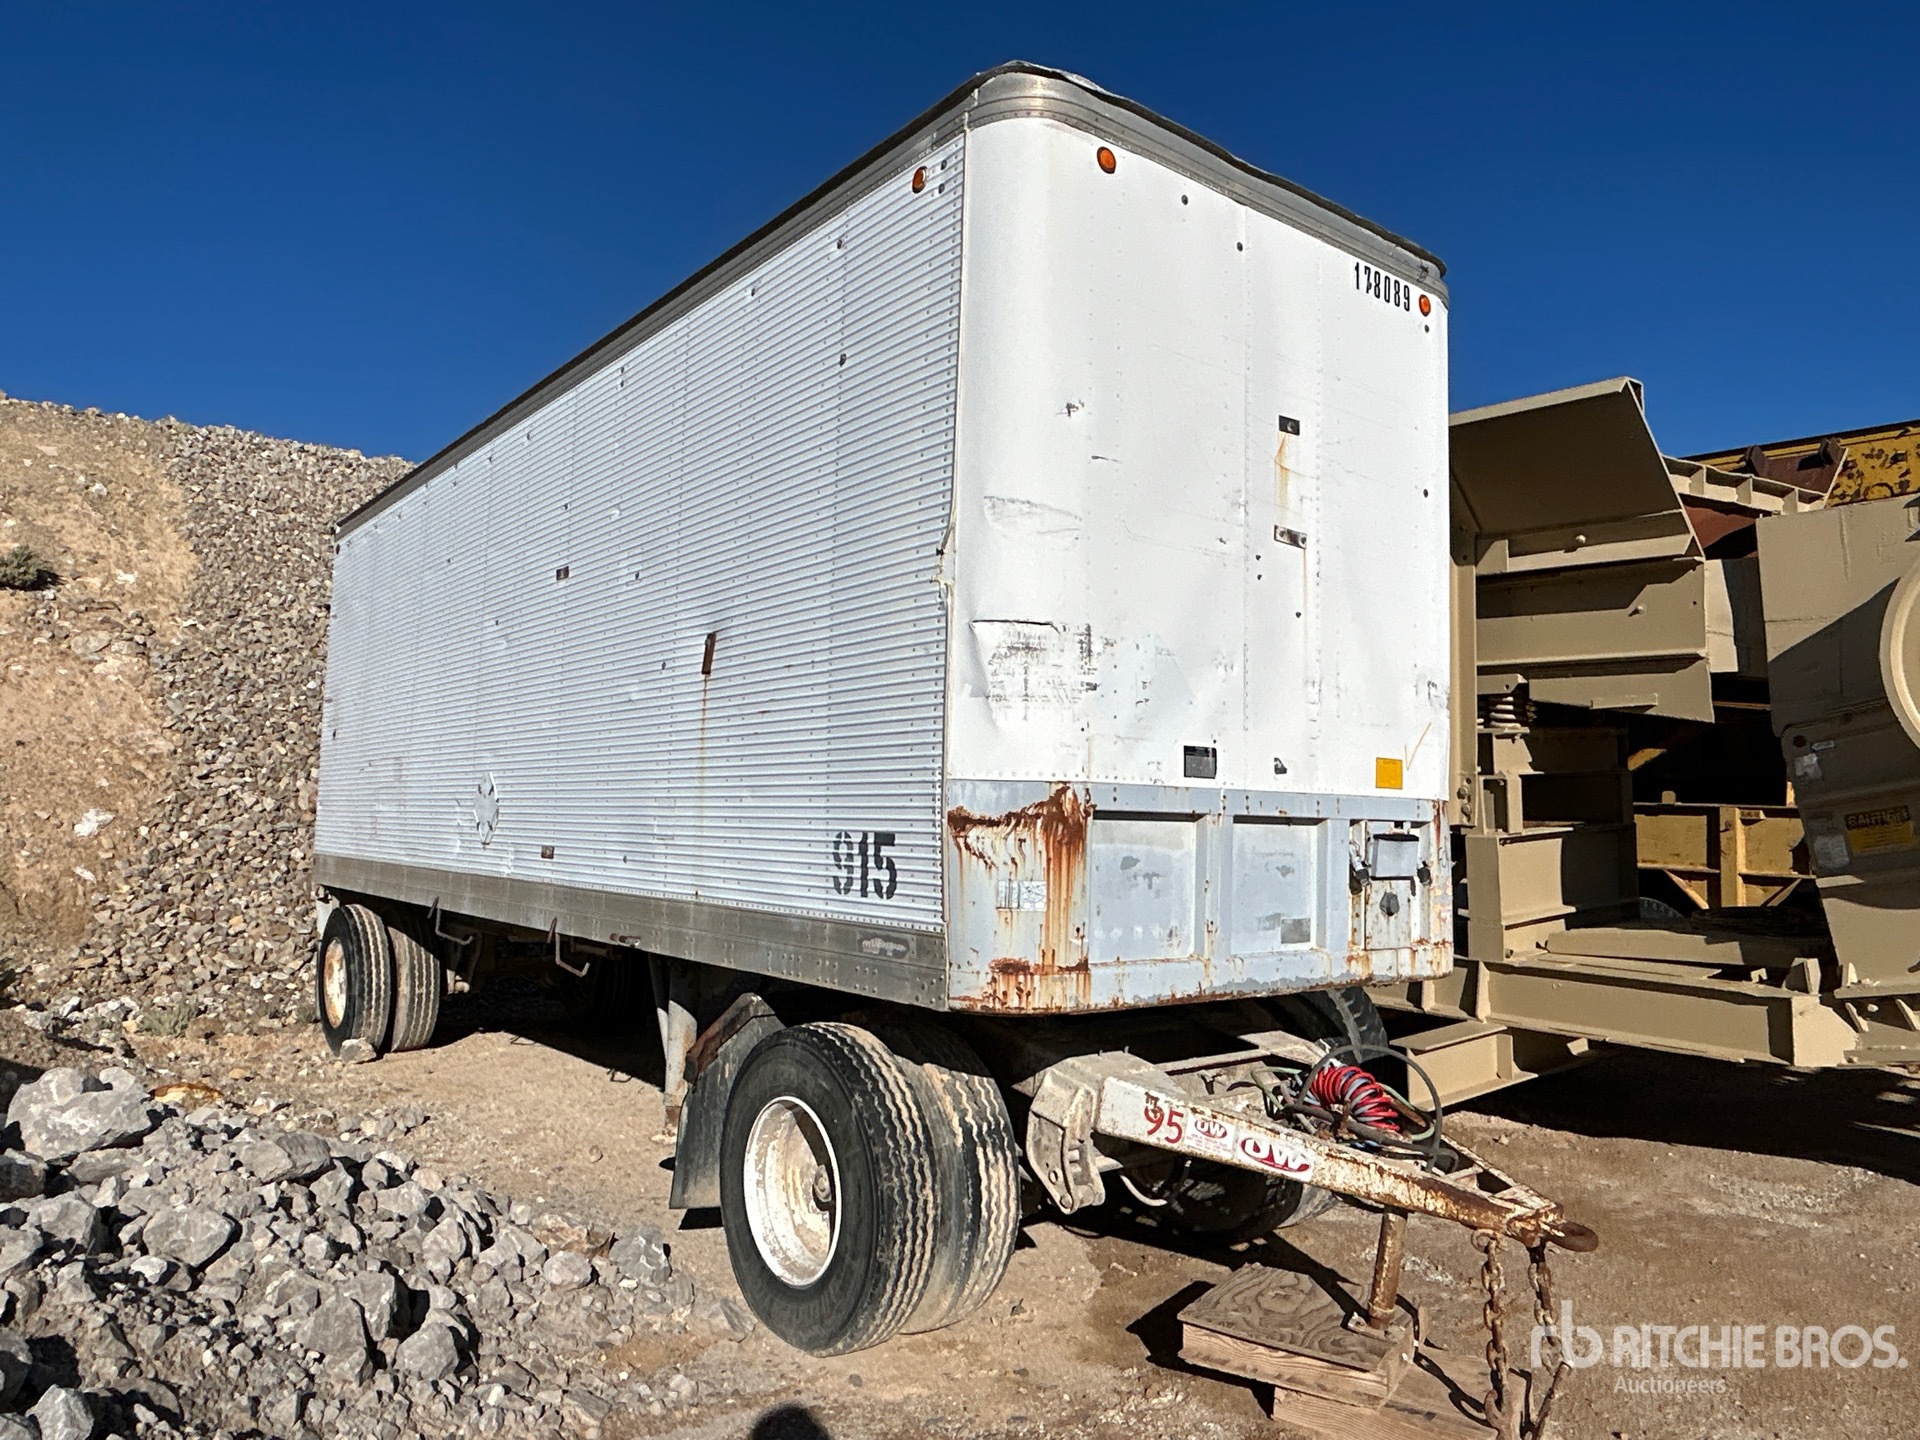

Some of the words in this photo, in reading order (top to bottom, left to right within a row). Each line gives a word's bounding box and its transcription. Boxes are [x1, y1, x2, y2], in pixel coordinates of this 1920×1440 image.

[1354, 261, 1411, 312] 178089
[832, 831, 898, 900] 915
[1144, 1105, 1185, 1144] 95
